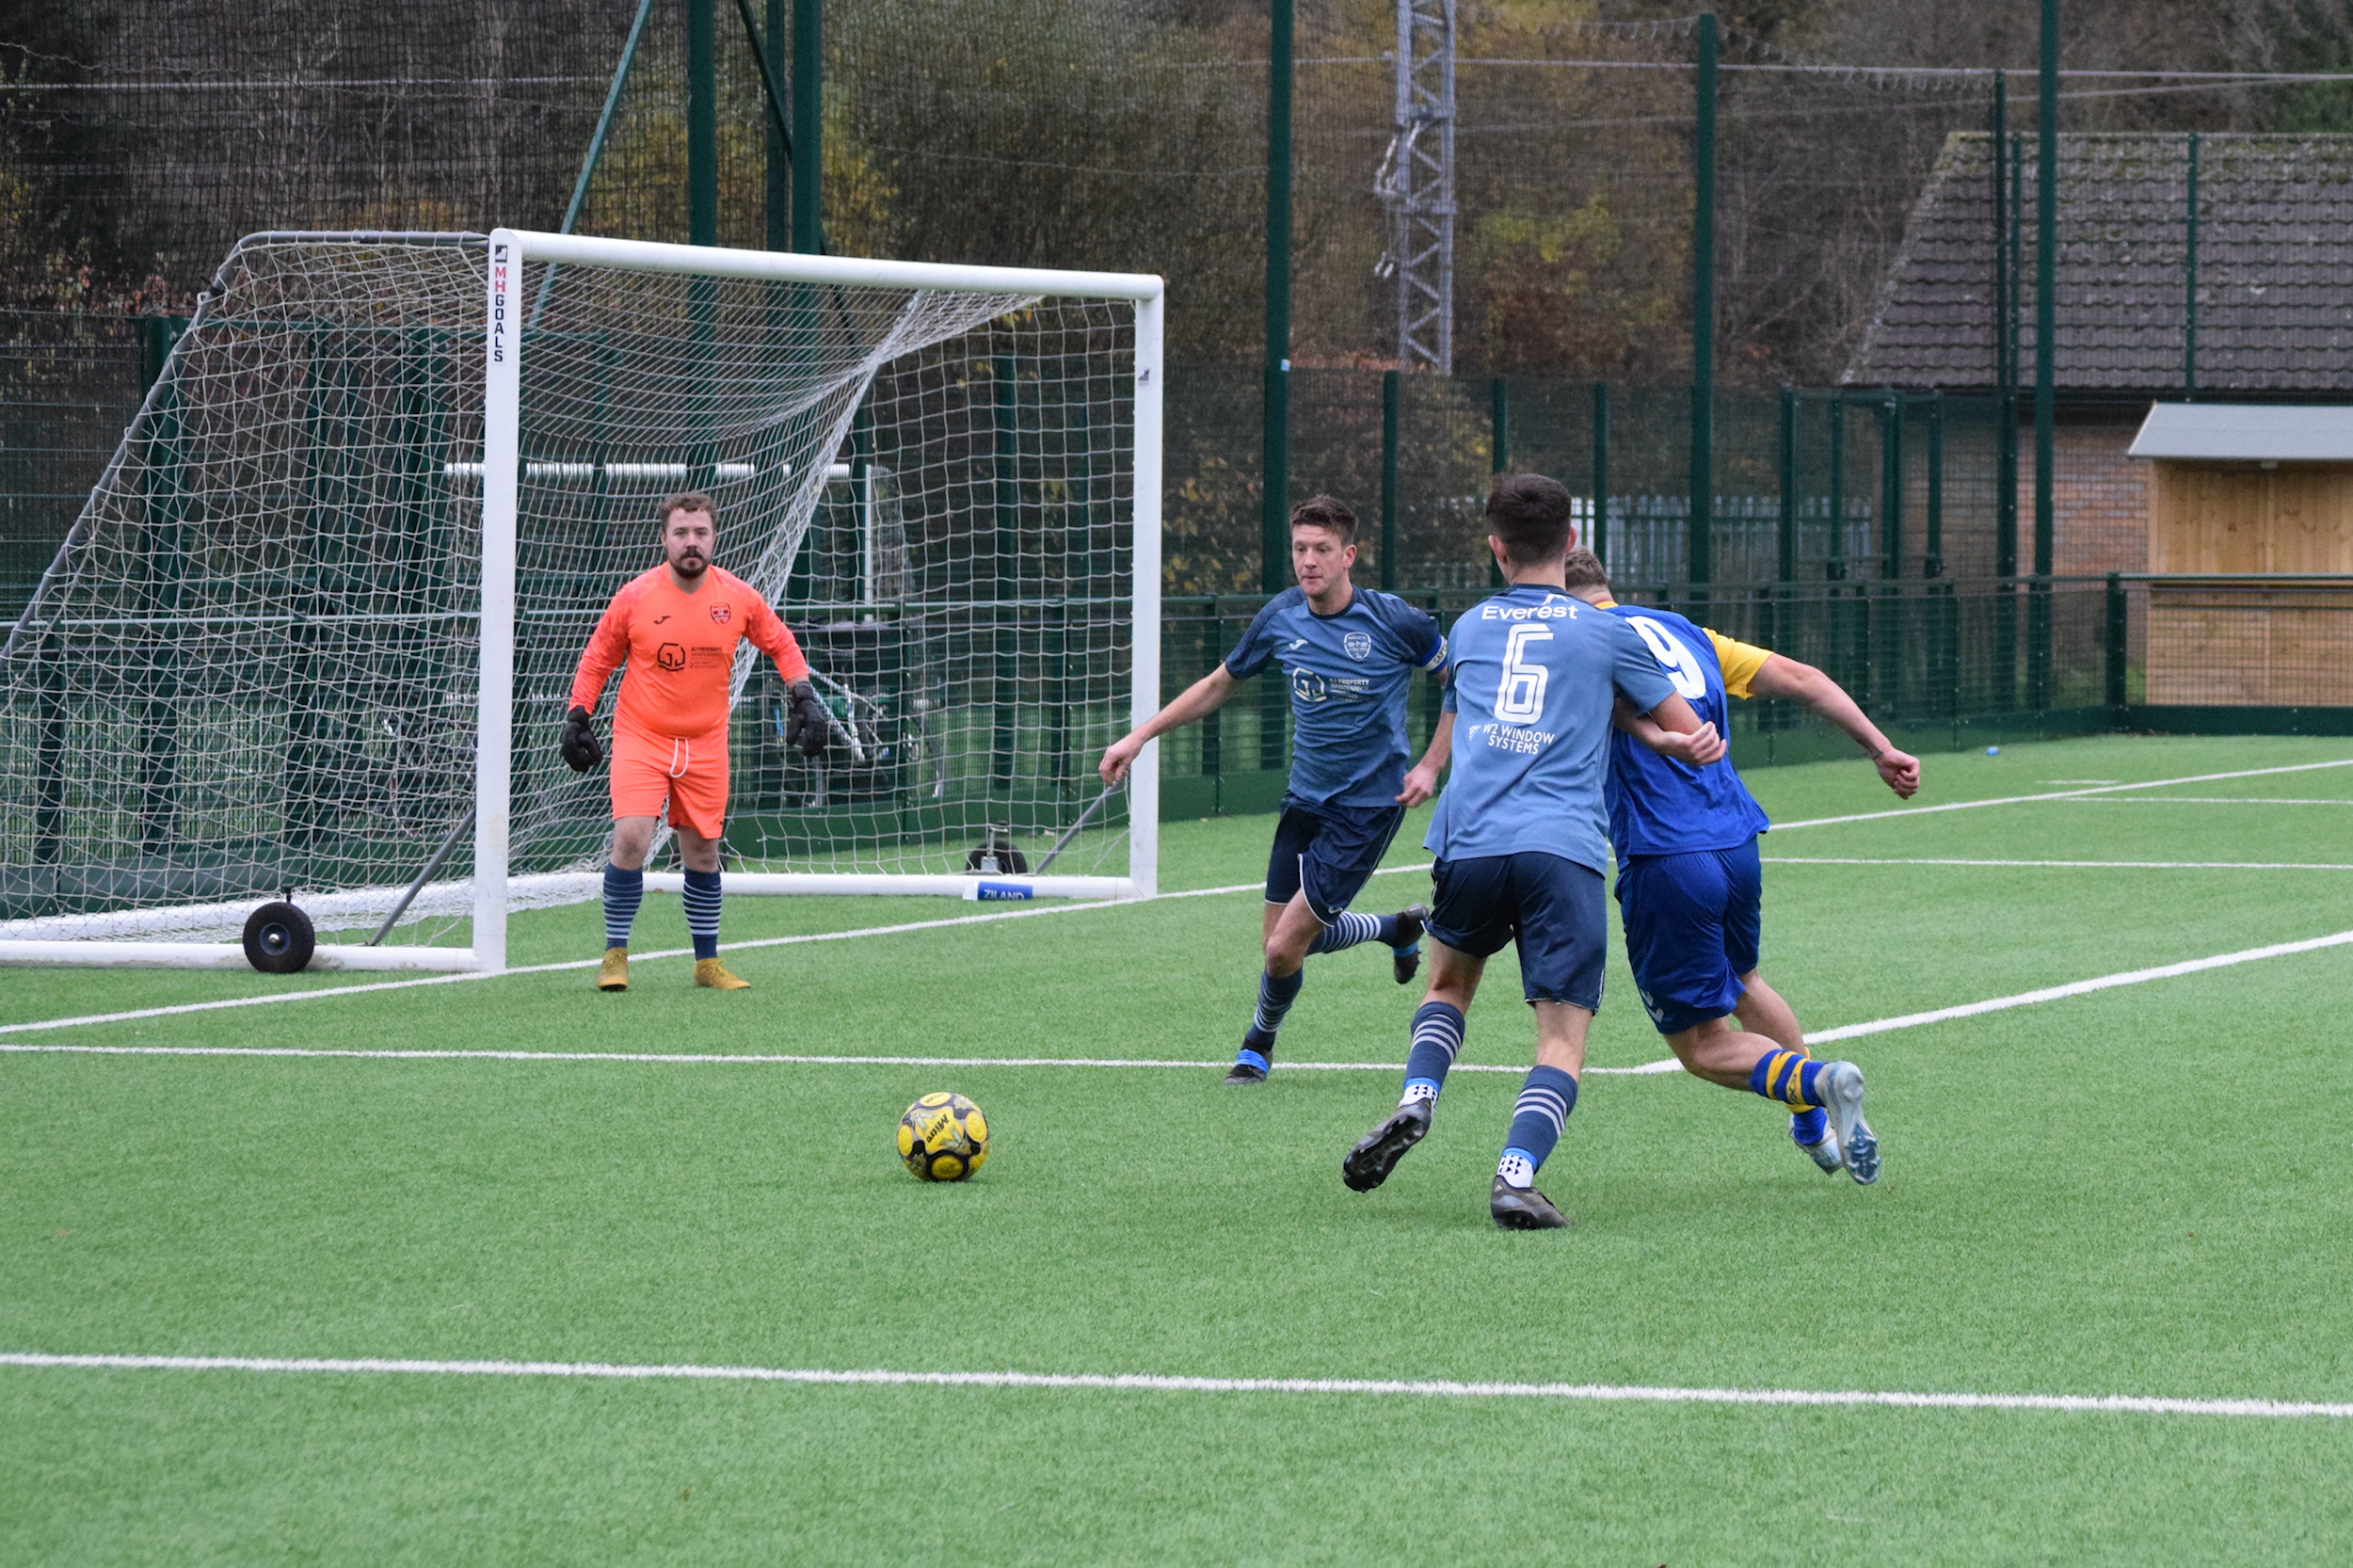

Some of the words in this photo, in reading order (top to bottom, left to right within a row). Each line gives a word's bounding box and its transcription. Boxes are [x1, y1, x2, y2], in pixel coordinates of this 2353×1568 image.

[1481, 605, 1578, 620] Everest
[1625, 616, 1706, 699] 9
[1494, 623, 1554, 725] 6
[1482, 724, 1498, 735] W2
[1501, 725, 1555, 745] WINDOW
[1488, 734, 1540, 755] SYSTEMS
